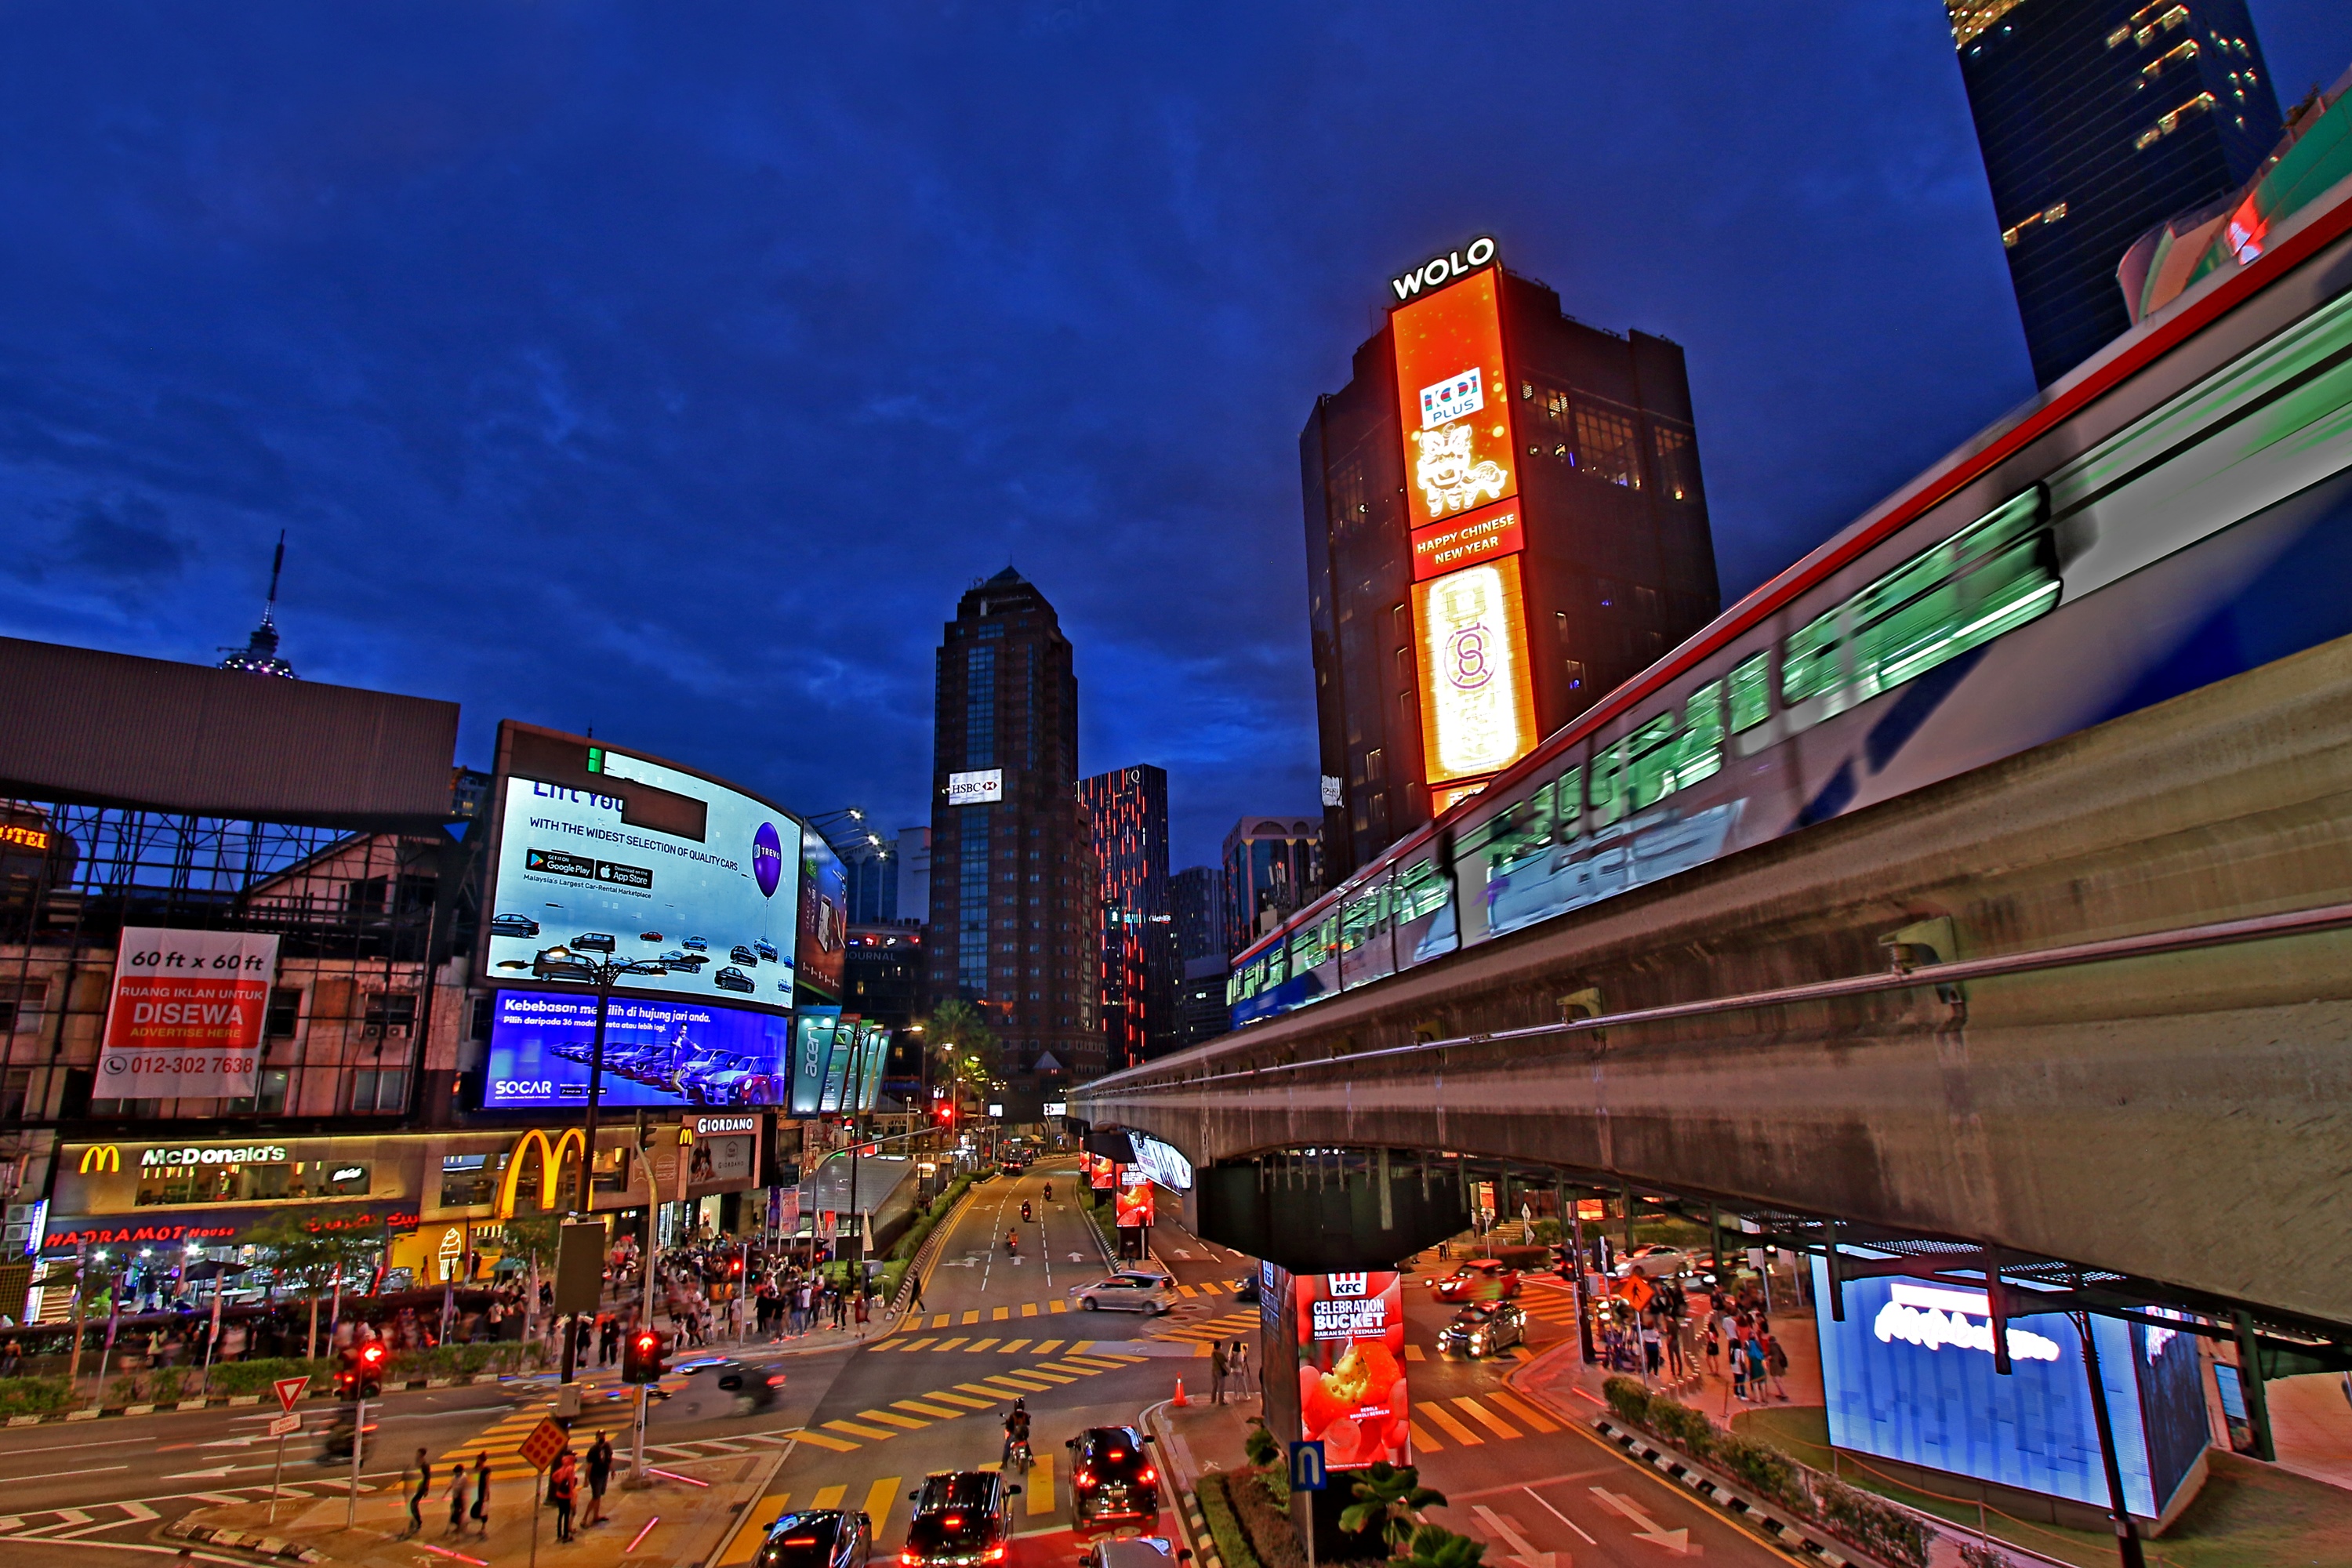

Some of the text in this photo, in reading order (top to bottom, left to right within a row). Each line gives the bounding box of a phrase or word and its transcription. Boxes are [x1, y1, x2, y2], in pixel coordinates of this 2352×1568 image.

[1392, 237, 1495, 300] WOLO
[1433, 398, 1474, 423] PLUS
[1417, 514, 1515, 554] HAPPY CHINESE
[1435, 535, 1499, 564] NEW YEAR
[1125, 770, 1141, 785] EQ
[952, 782, 982, 794] HSBC
[529, 816, 739, 872] WITH THE WIDEST SELECTION OF QUALITY CARS
[761, 848, 781, 860] TREVO
[546, 861, 590, 876] Google Play
[613, 871, 648, 884] App Store
[523, 873, 652, 899] Malaysia's Largest Car-Rental Marketplace
[132, 952, 265, 971] 60 ft x 60 ft
[120, 987, 263, 1000] RUANG IKLAN UNTUK
[133, 1003, 245, 1025] DISEWA
[504, 999, 578, 1014] Kebebasan
[626, 1006, 637, 1017] di
[638, 1007, 672, 1022] hujung
[671, 1010, 688, 1022] jari
[688, 1012, 711, 1022] anda.
[130, 1027, 241, 1038] ADVERTISE HERE
[503, 1015, 523, 1024] Pilih
[524, 1017, 561, 1026] daripada
[654, 1024, 666, 1033] lagi.
[805, 1030, 819, 1077] acer
[131, 1057, 253, 1073] 012-302 7638
[495, 1080, 552, 1094] SOCAR
[697, 1117, 753, 1134] GIORDANO
[140, 1145, 287, 1166] McDonald's
[718, 1160, 744, 1169] GIORDANO
[44, 1225, 187, 1248] HADRAMOT
[1335, 1283, 1361, 1294] KFC
[1313, 1299, 1385, 1315] CELEBRATION
[1313, 1312, 1385, 1330] BUCKET
